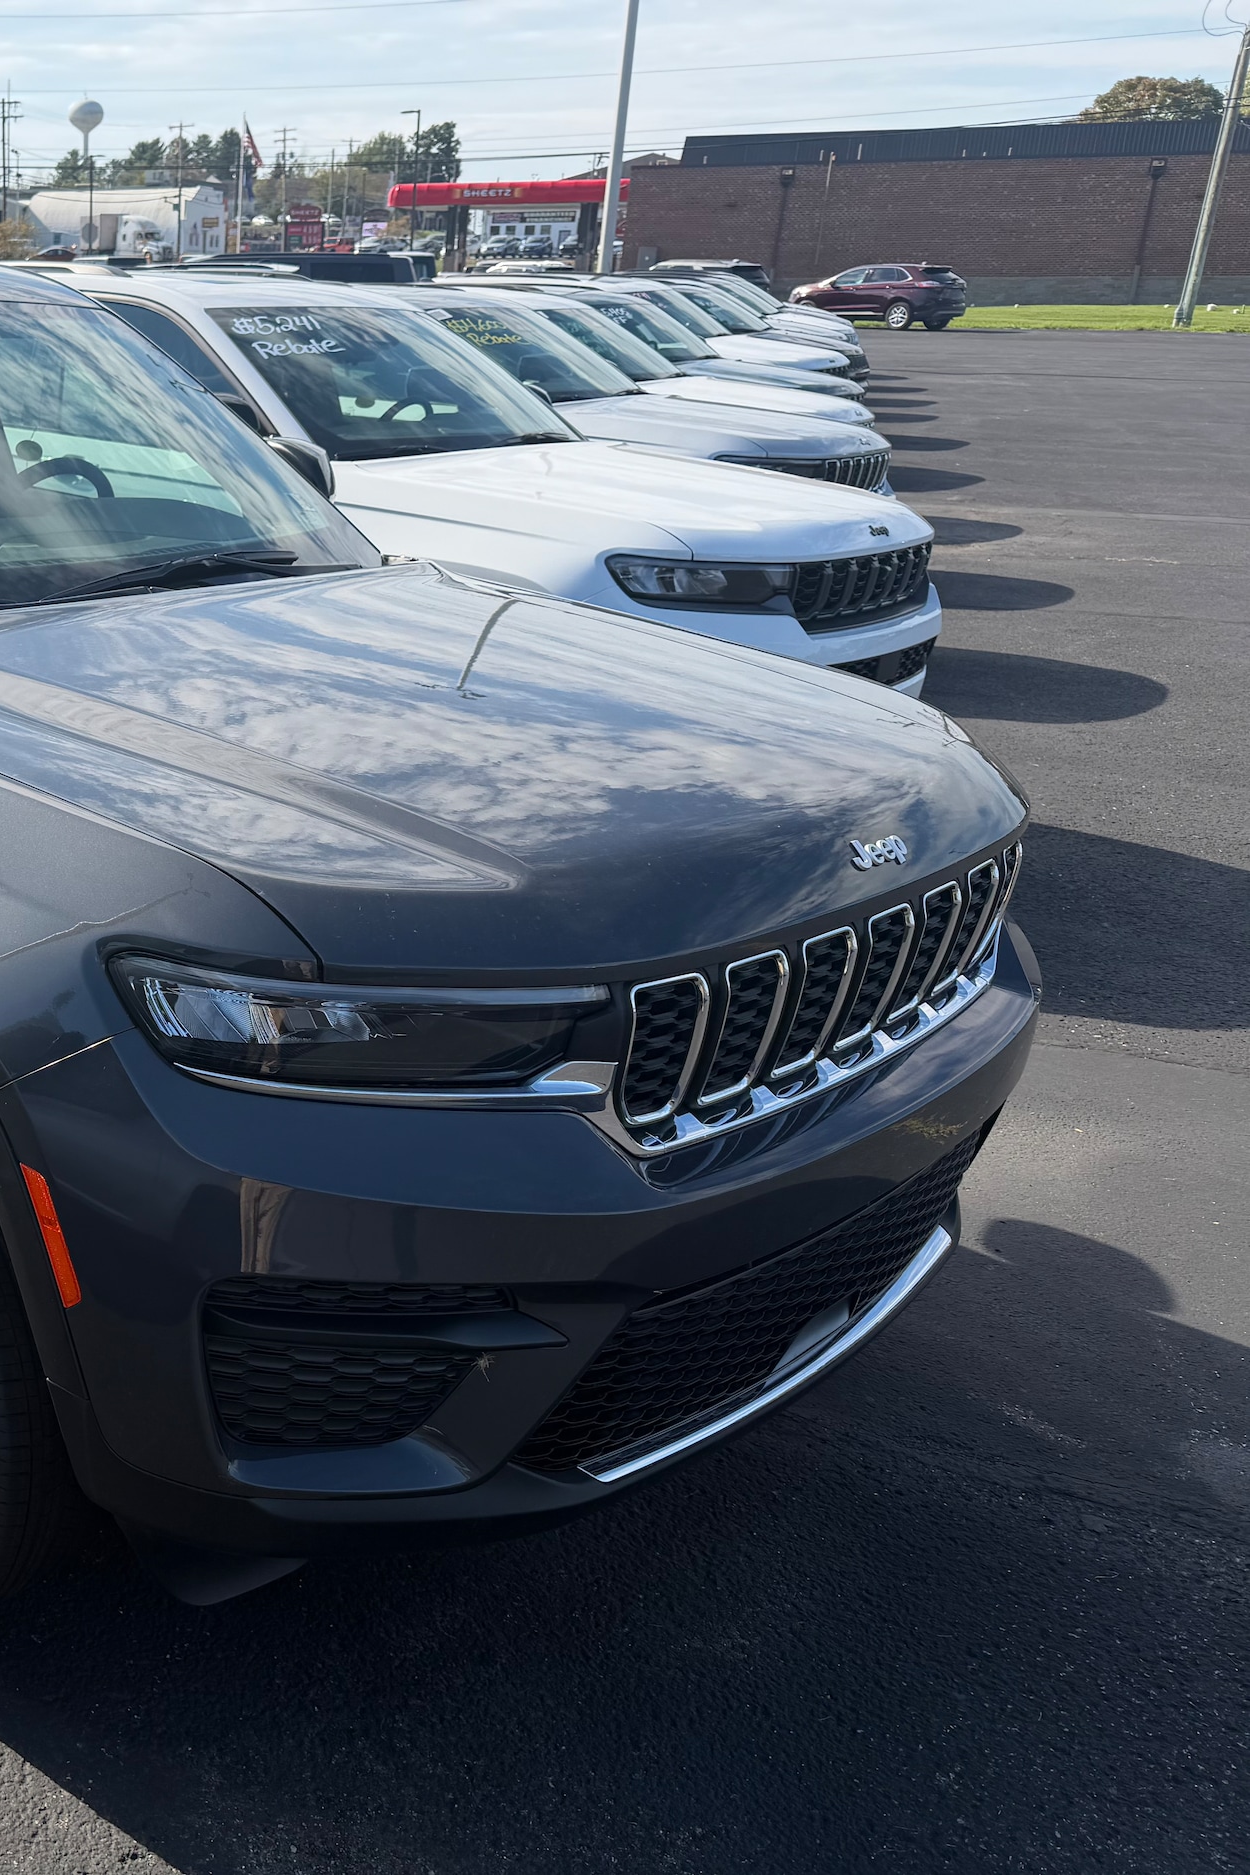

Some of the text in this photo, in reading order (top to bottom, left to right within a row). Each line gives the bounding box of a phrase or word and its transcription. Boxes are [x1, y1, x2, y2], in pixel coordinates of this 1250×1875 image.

[463, 189, 512, 198] SHEETZ
[231, 315, 321, 335] $5,241
[251, 339, 347, 360] Rebate
[466, 332, 530, 347] Rebate
[850, 834, 908, 870] Jeep
